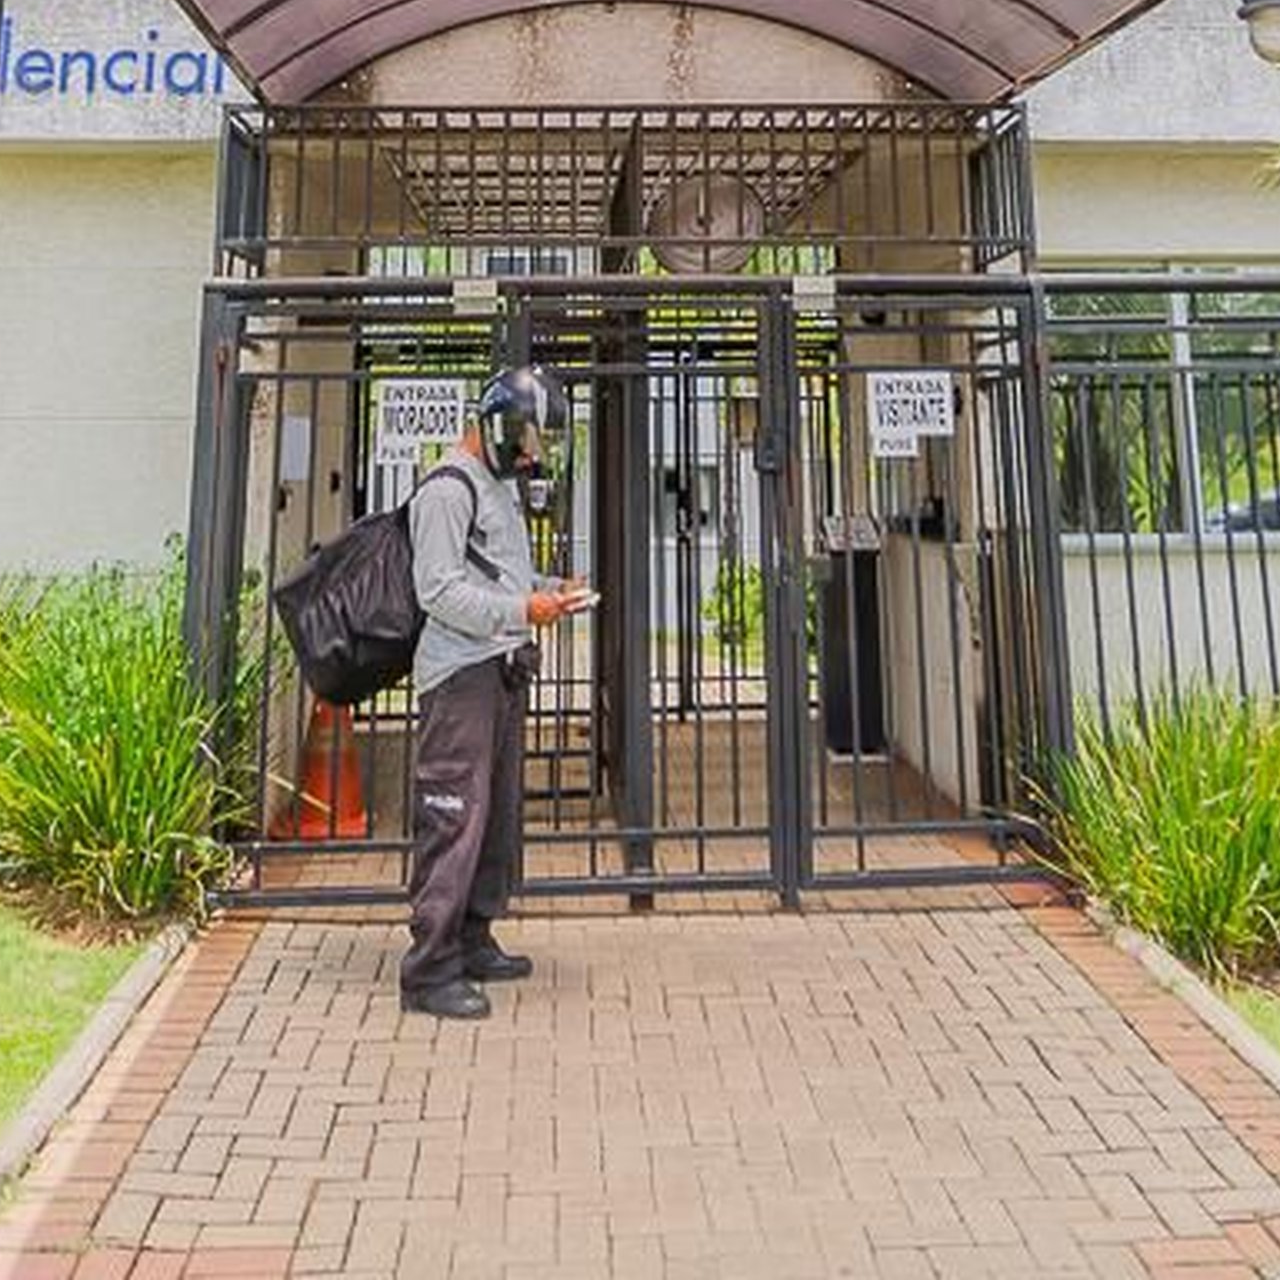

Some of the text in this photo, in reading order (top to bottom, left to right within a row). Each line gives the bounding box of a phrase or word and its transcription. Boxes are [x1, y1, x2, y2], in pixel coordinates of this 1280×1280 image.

[383, 385, 458, 401] ENTRADA
[875, 379, 945, 394] ENTRADA
[382, 404, 458, 435] MORADOR
